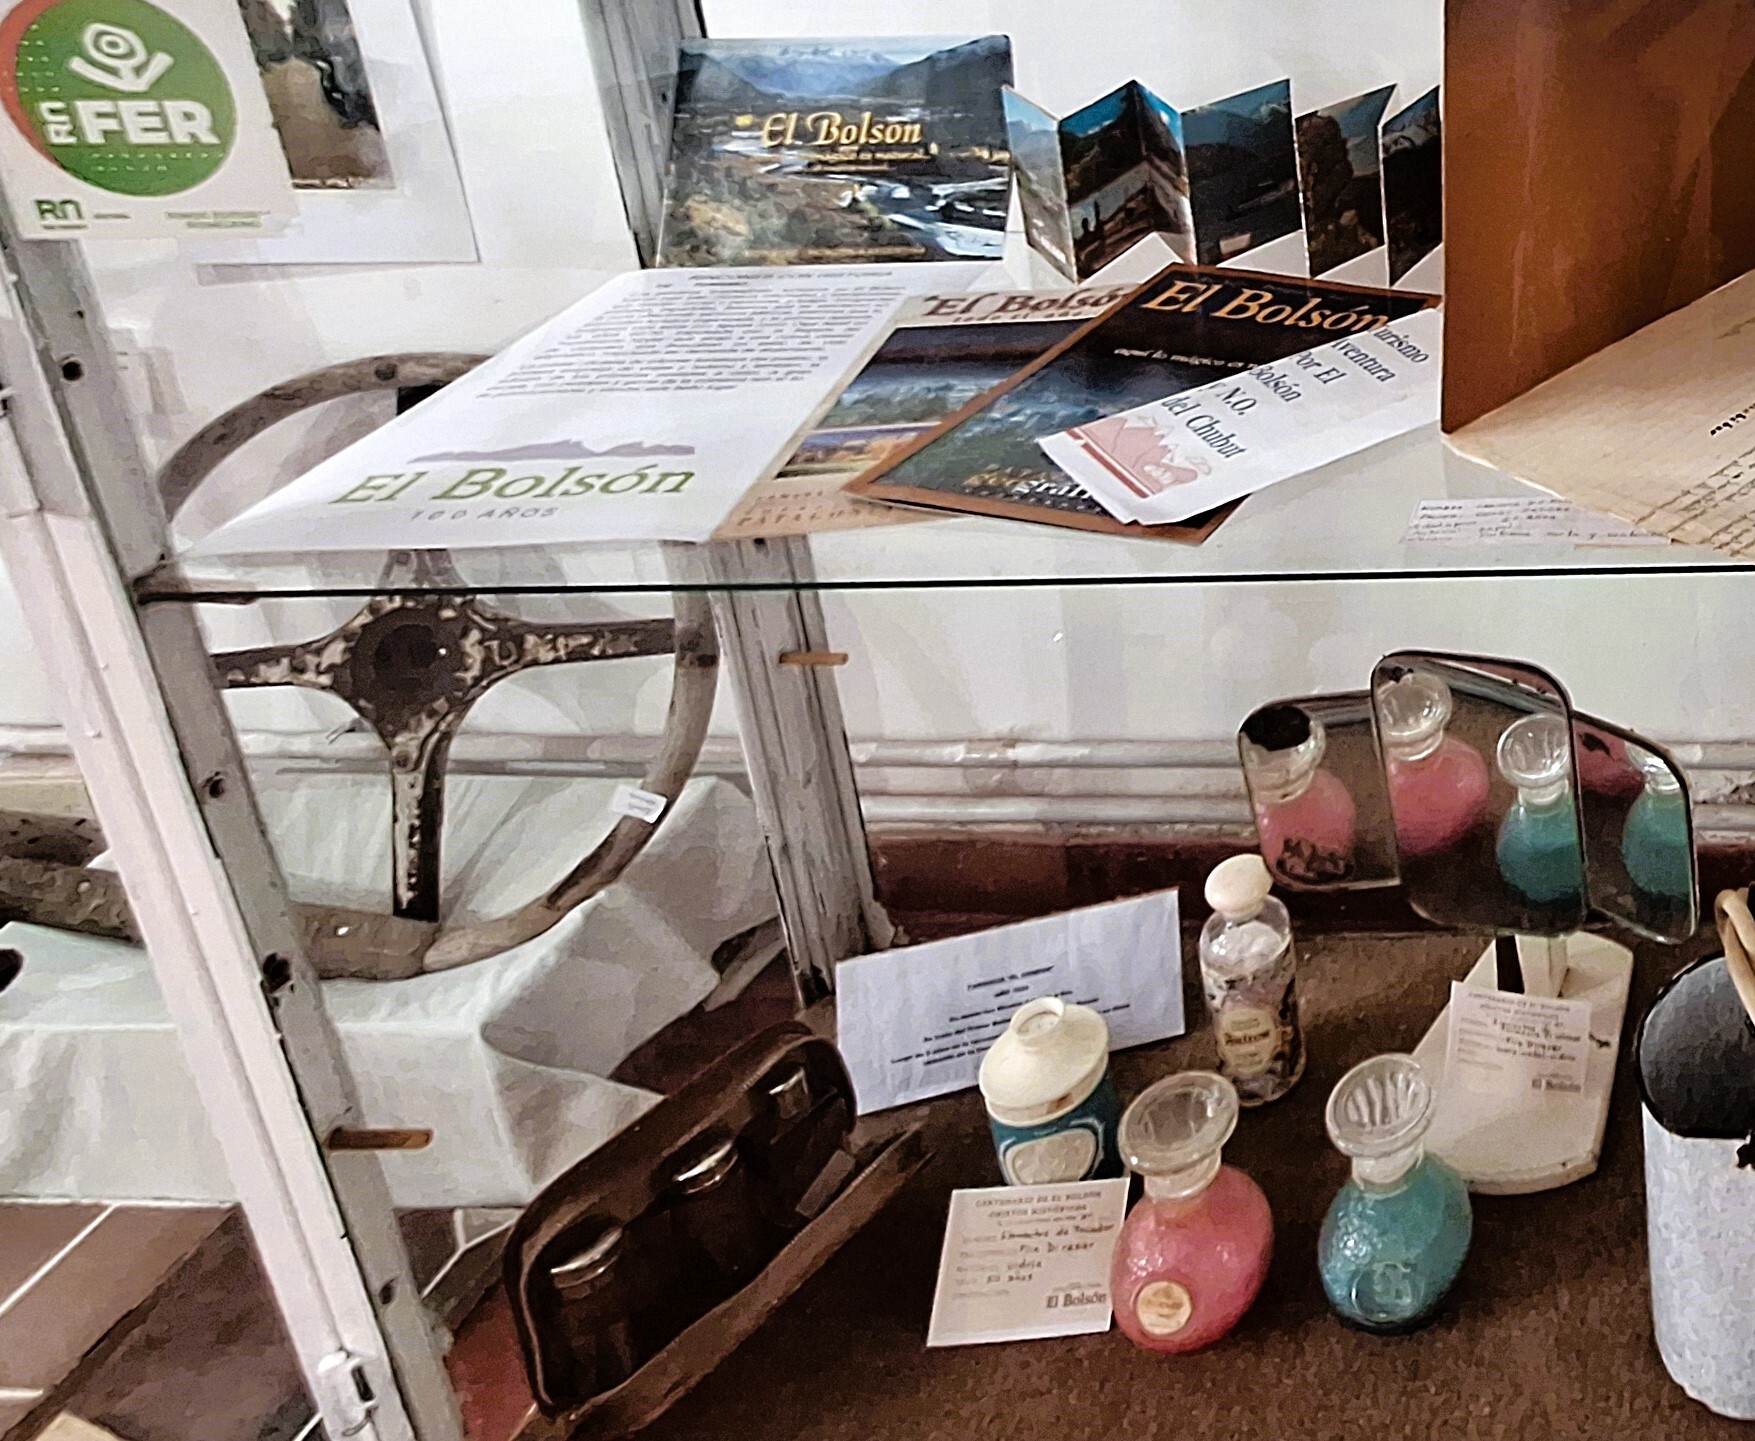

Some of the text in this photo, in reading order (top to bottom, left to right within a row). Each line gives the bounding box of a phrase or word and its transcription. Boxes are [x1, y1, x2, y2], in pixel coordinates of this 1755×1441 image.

[76, 100, 221, 146] FER
[762, 111, 923, 147] El Bolson
[924, 287, 1124, 316] El Bolsó
[1141, 280, 1389, 332] El Bolsón
[1249, 365, 1301, 403] Bolsón
[1314, 368, 1348, 385] El
[1161, 396, 1248, 459] del Chubut
[333, 463, 696, 505] El Bolsón
[409, 506, 560, 522] 100 AÑOS
[1047, 1292, 1107, 1309] El Bolsón
